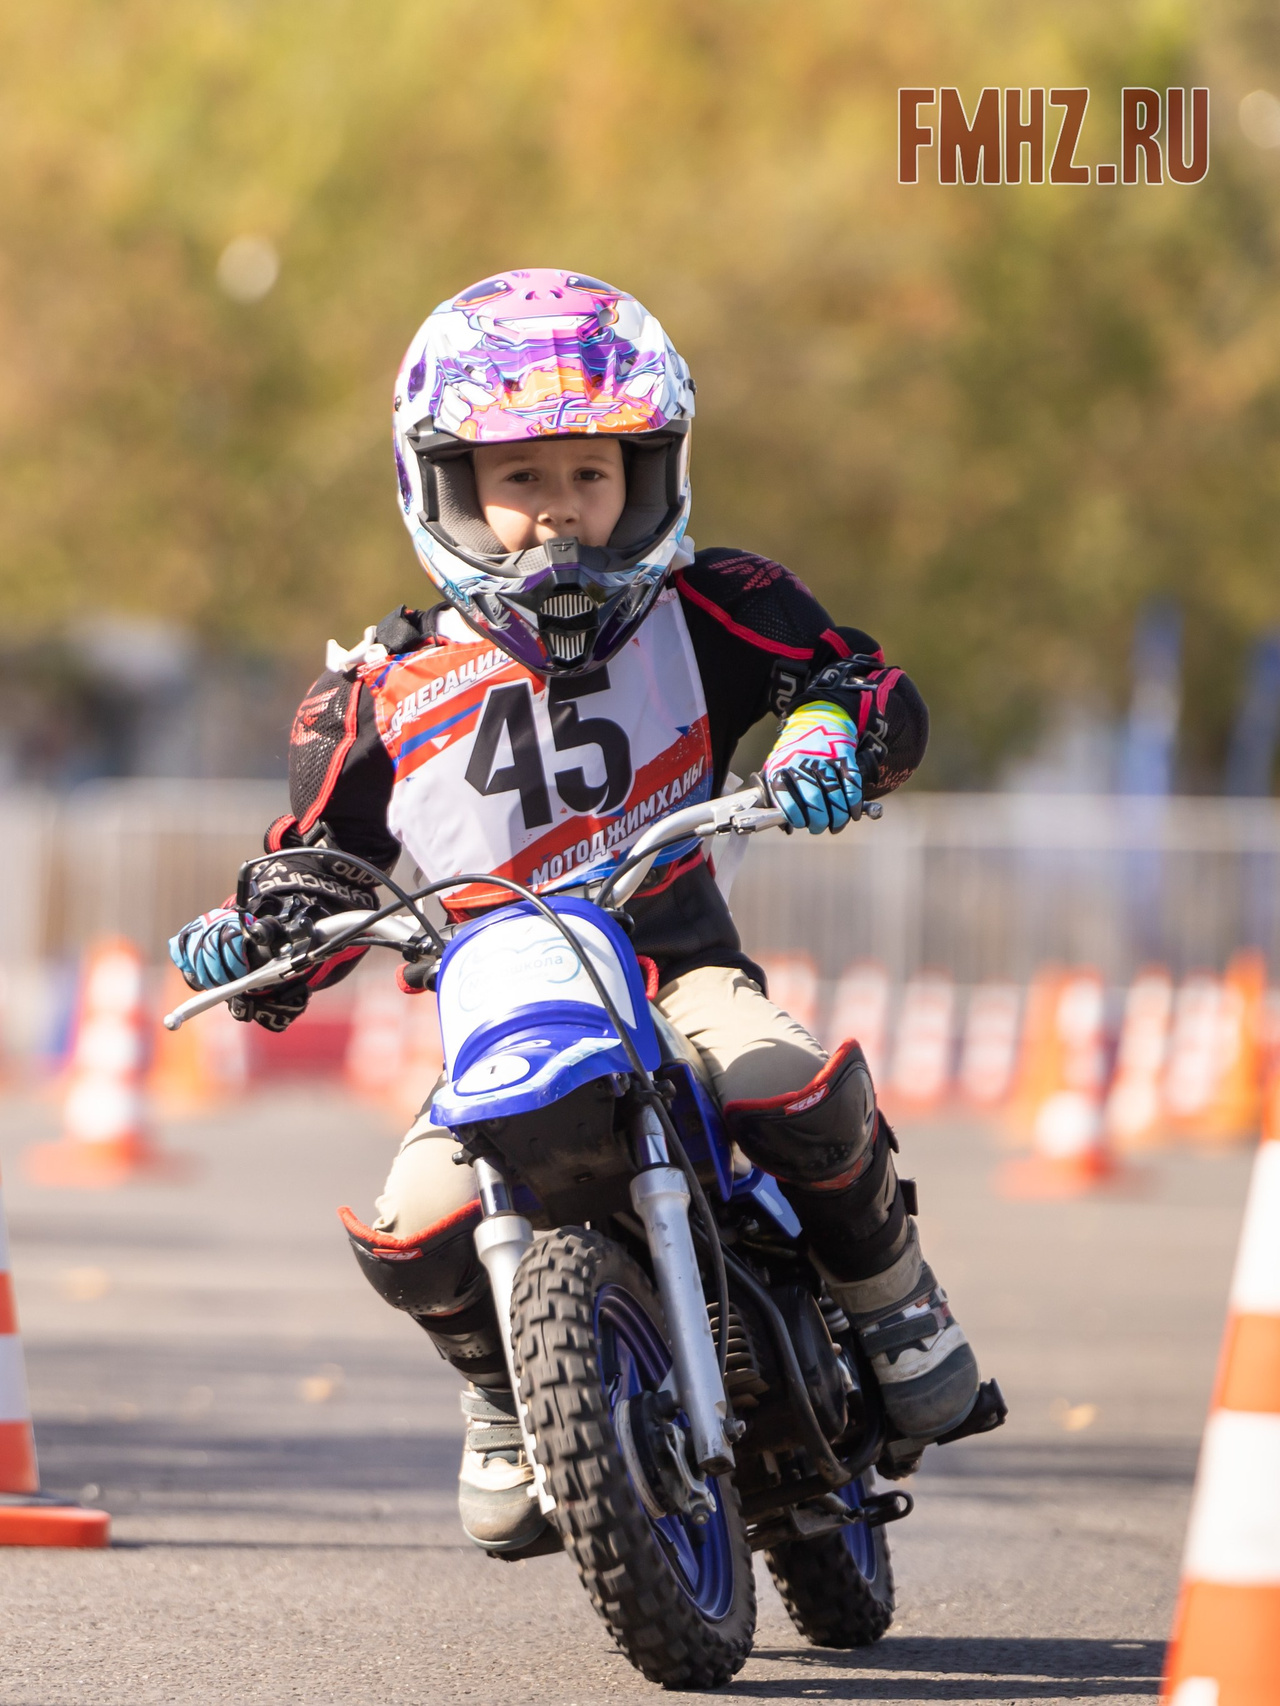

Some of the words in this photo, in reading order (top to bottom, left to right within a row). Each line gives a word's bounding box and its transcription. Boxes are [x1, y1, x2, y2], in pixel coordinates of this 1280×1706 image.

[391, 647, 513, 731] ДЕРАЦИЯ
[465, 664, 632, 830] 45
[531, 755, 706, 893] МОТОДЖИМХАНЫ
